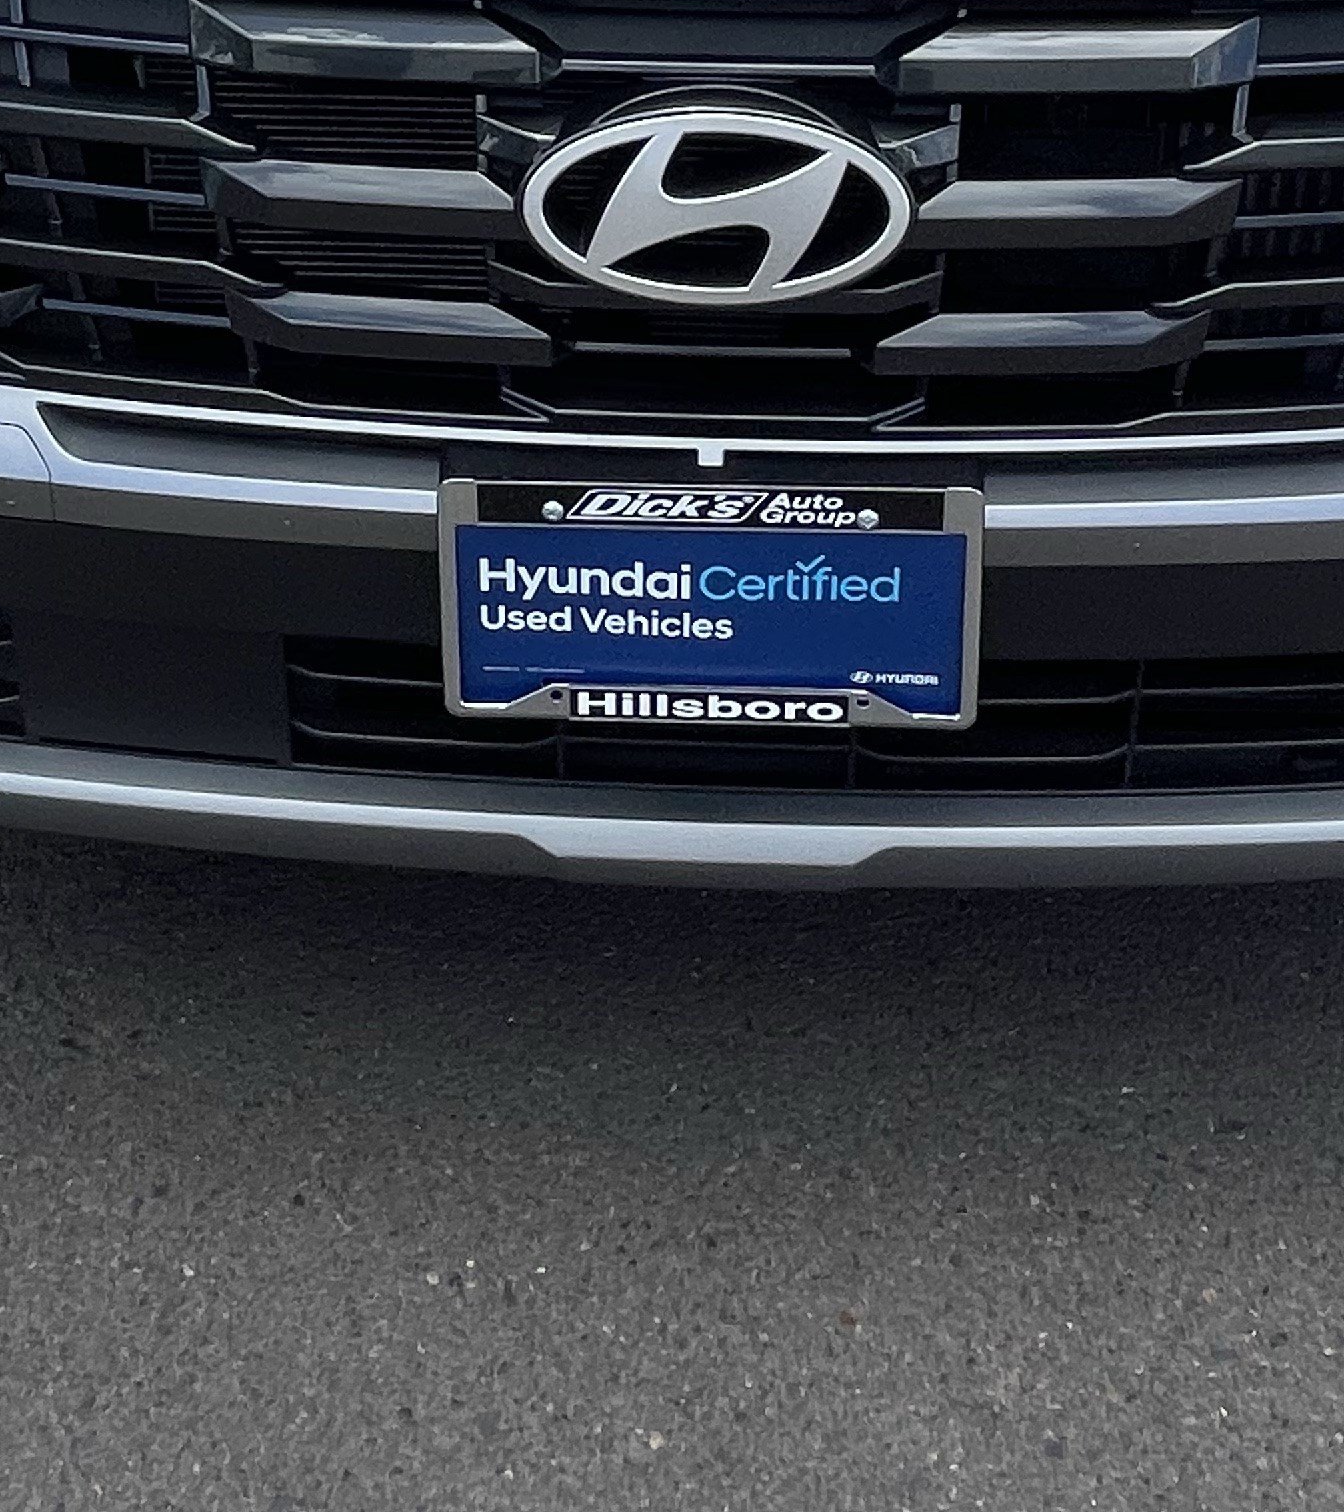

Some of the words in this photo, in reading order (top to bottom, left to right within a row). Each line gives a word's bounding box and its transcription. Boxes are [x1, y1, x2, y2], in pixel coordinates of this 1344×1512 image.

[580, 492, 745, 519] Dick's
[768, 492, 843, 510] Auto
[760, 508, 856, 528] Group
[478, 557, 692, 601] Hyundai
[699, 556, 901, 602] Certified
[479, 604, 572, 632] Used
[580, 608, 734, 639] Vehicles
[577, 691, 844, 722] Hillsboro
